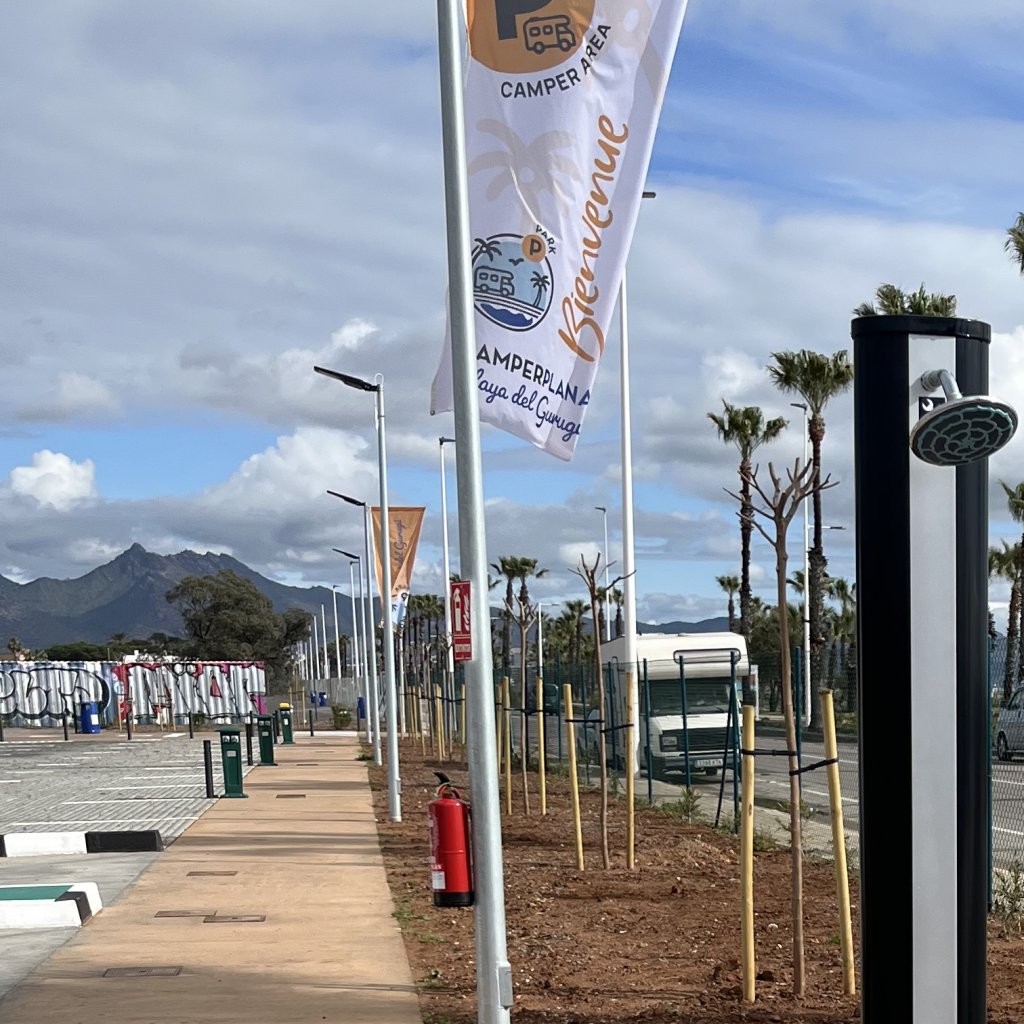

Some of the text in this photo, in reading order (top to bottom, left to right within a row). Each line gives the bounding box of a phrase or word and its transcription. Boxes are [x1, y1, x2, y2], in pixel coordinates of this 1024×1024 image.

[501, 24, 611, 98] CAMPER AREA
[535, 224, 557, 254] PARK
[558, 114, 629, 363] Bienvenue
[476, 343, 590, 406] AMPERPLANA
[512, 384, 533, 411] del
